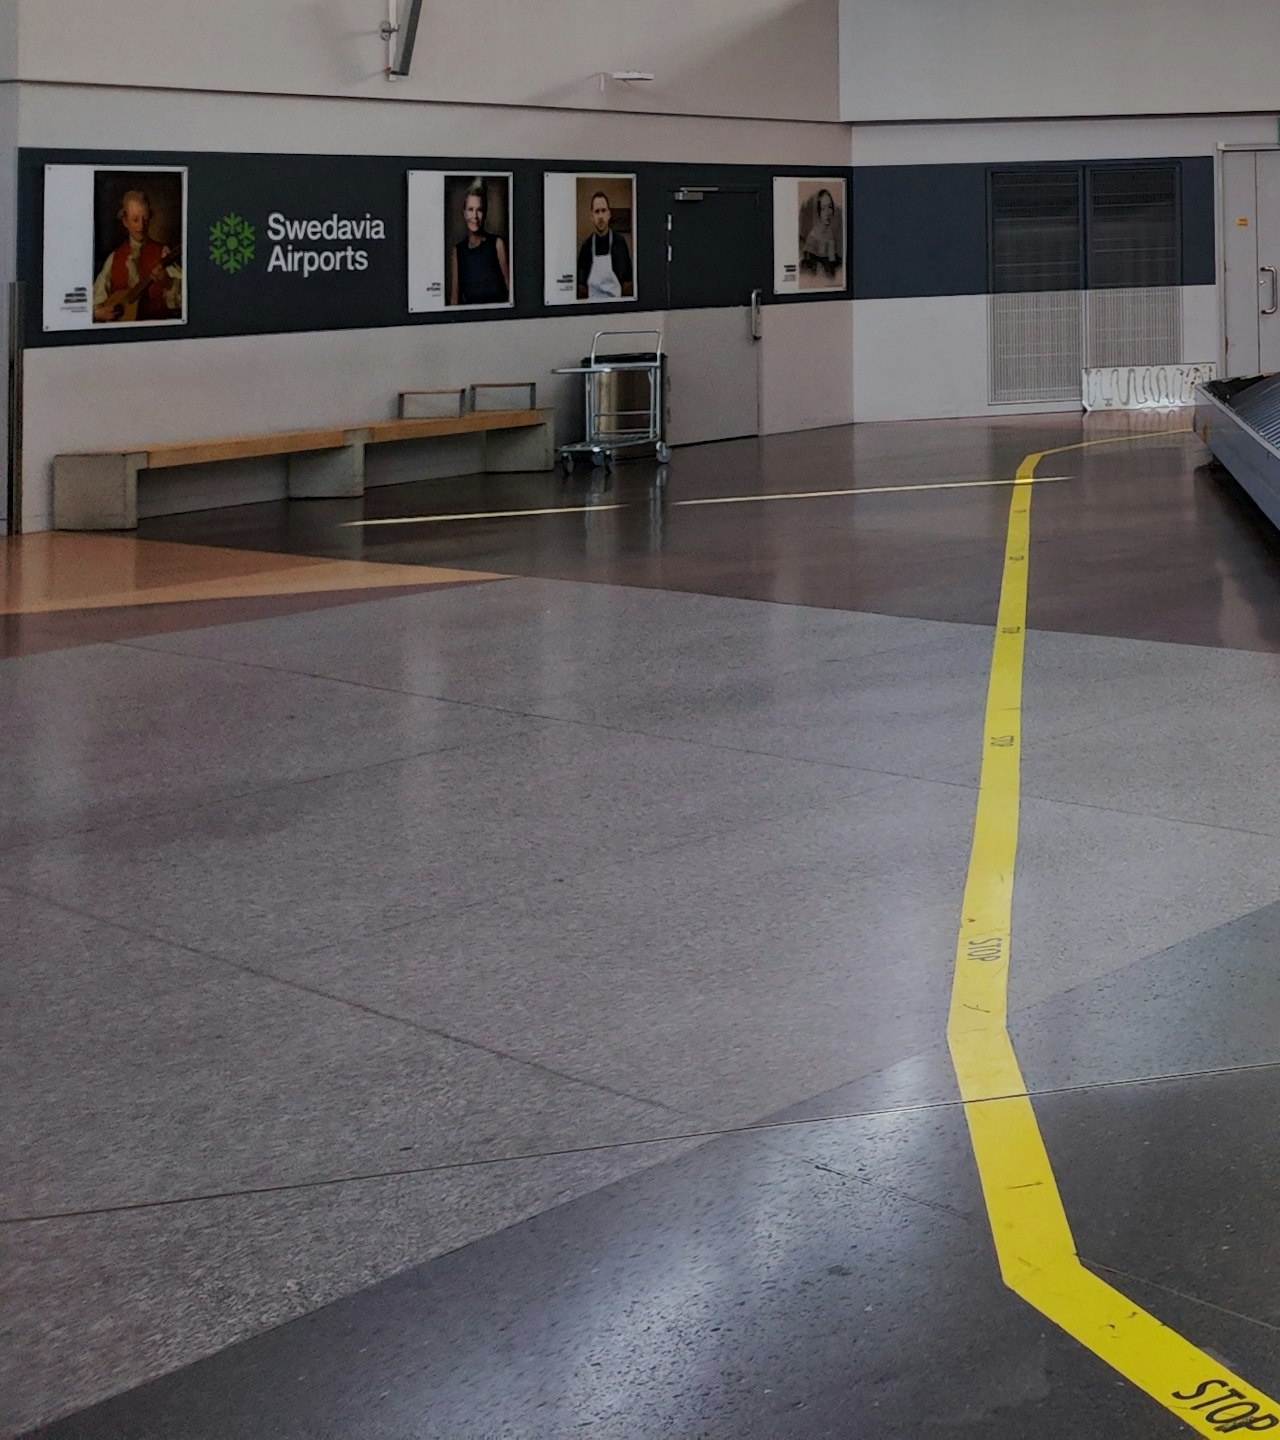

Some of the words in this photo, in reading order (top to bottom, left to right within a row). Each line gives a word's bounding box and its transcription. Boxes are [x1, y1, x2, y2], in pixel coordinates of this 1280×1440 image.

[267, 212, 386, 241] Swedavia
[267, 244, 369, 278] Airports
[966, 937, 1003, 962] STOP
[1171, 1379, 1280, 1435] STOP
